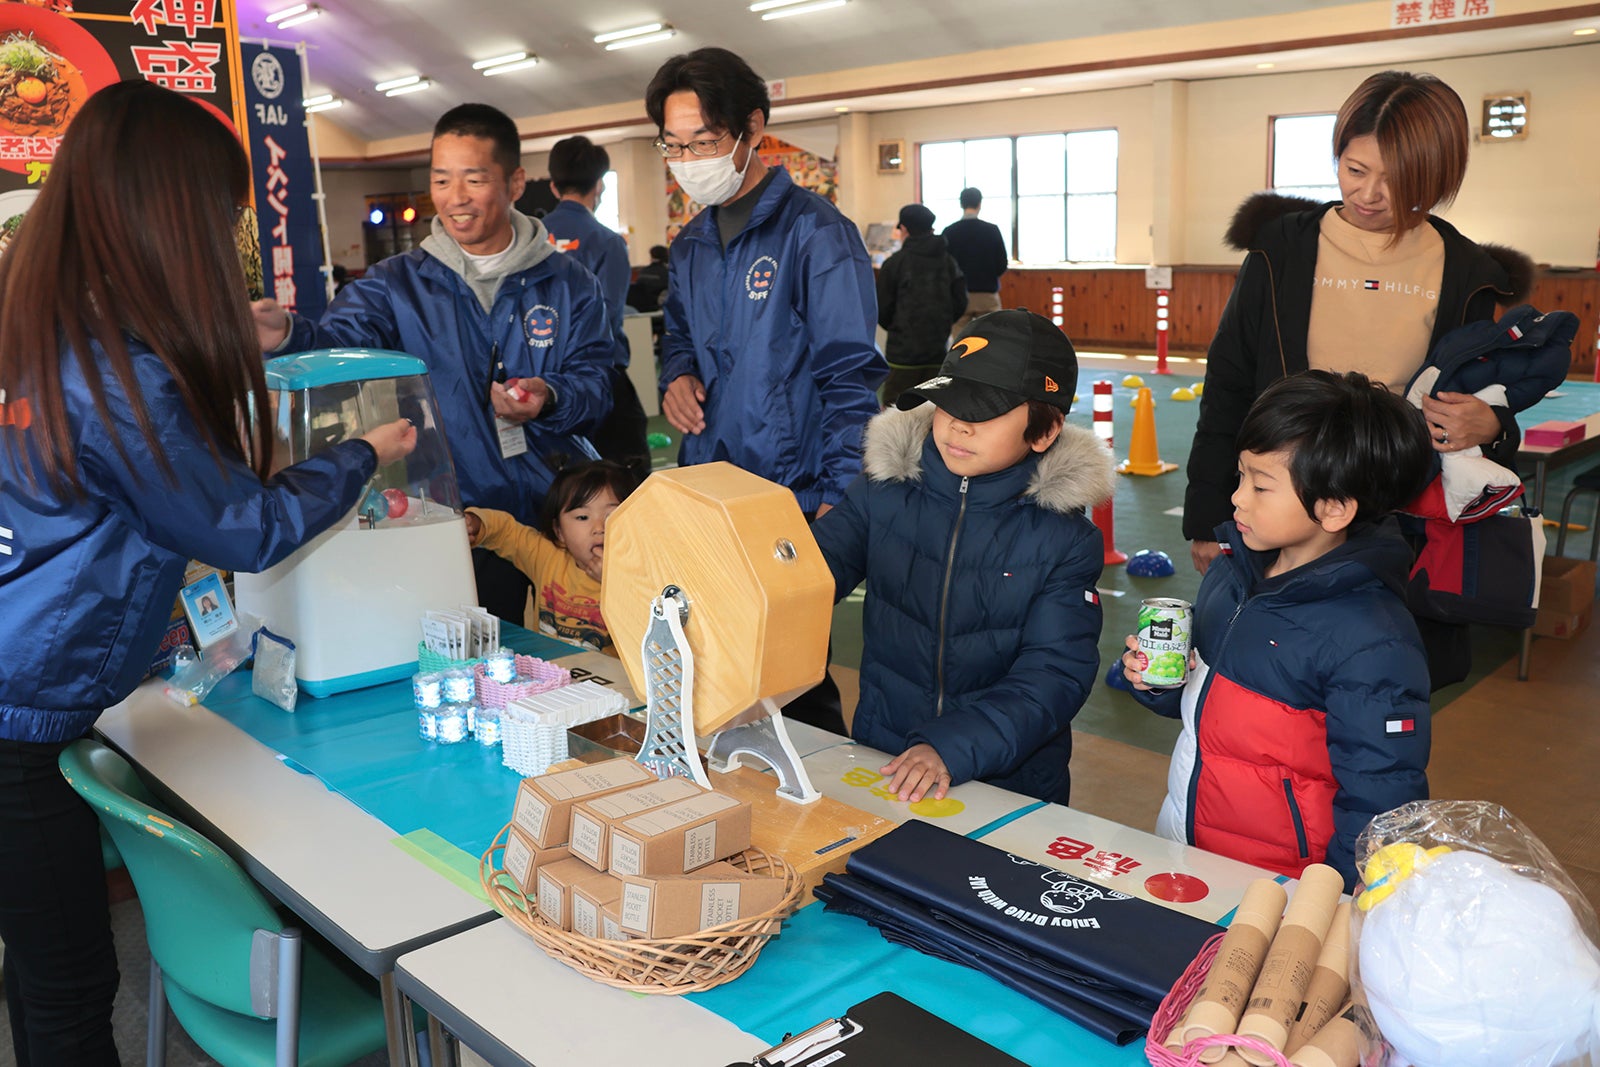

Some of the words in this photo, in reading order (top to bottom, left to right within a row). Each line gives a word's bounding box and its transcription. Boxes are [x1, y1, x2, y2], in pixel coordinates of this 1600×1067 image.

[1396, 0, 1490, 25] 禁煙席
[0, 136, 64, 159] 煮込
[1385, 281, 1437, 300] HILFIG
[528, 337, 554, 348] STAFF
[1045, 836, 1142, 882] 赤色
[968, 875, 990, 890] JAF
[707, 887, 716, 928] STAINLESS
[725, 899, 733, 922] OTTLE
[977, 889, 1008, 911] with
[716, 898, 724, 925] POCKET
[1004, 905, 1049, 927] Drive
[1050, 917, 1101, 929] Enjoy
